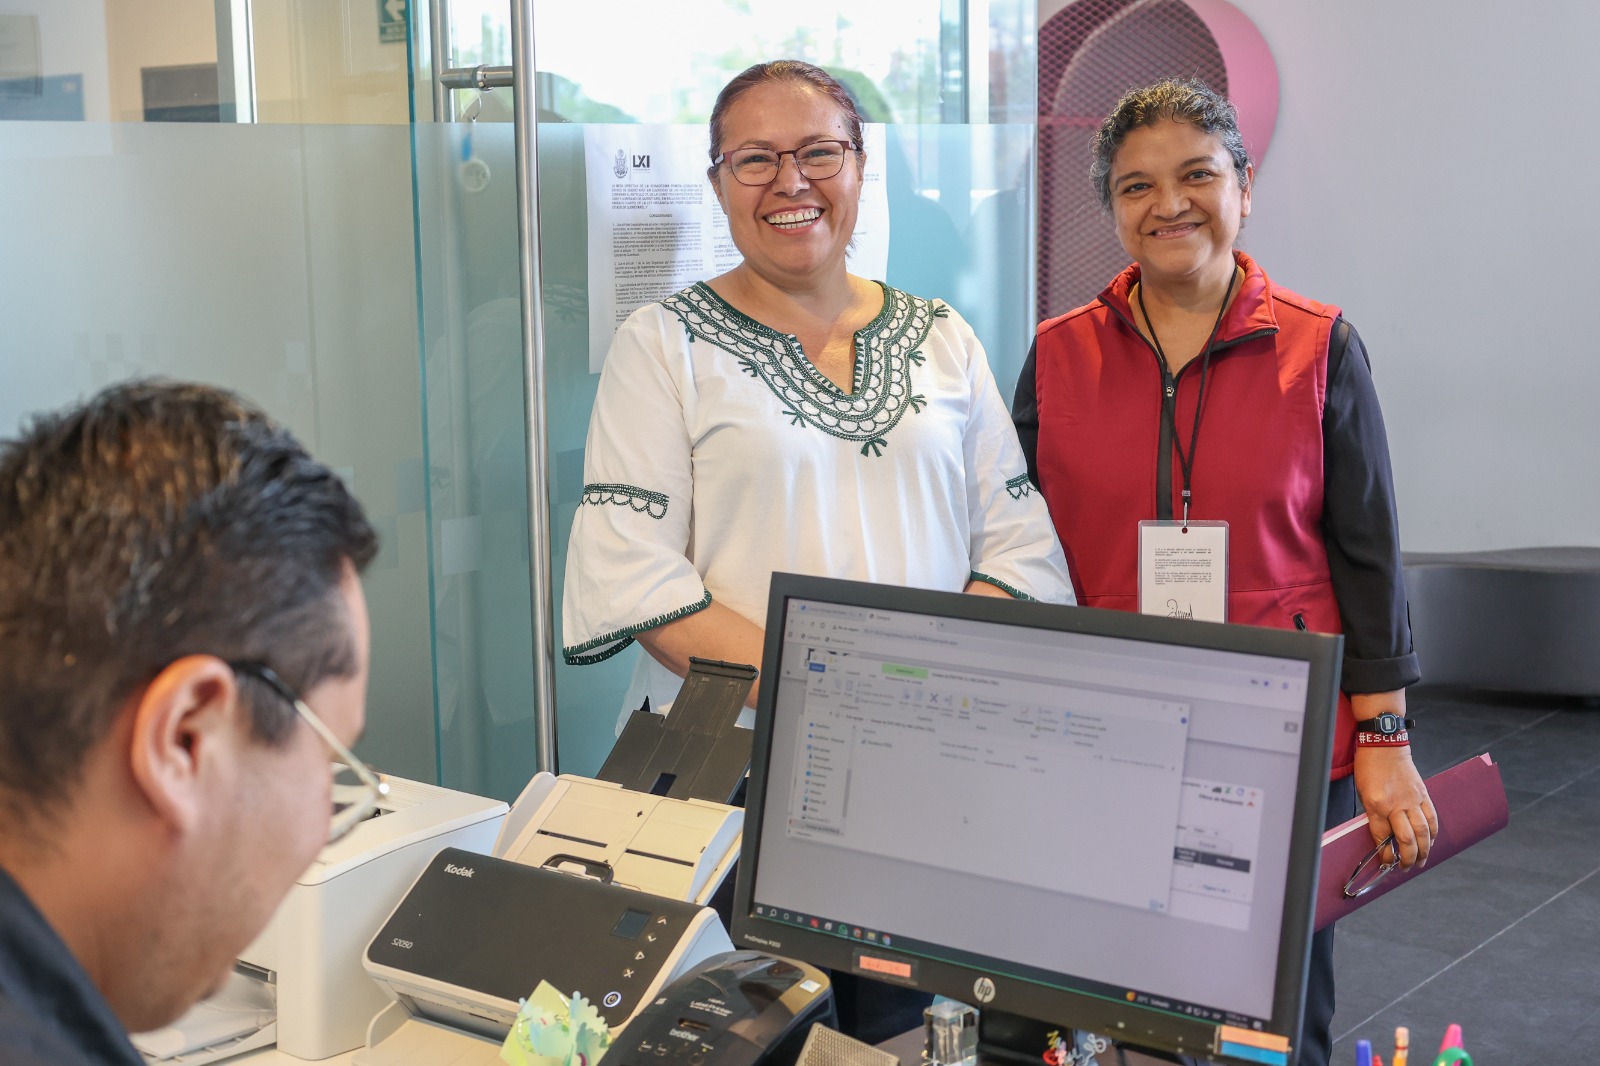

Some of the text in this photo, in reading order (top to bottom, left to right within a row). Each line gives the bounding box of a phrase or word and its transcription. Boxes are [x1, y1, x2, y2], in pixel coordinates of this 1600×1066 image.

[632, 155, 651, 168] LXI
[443, 863, 475, 878] Kodak
[975, 977, 994, 1002] hp
[669, 1028, 699, 1041] brother
